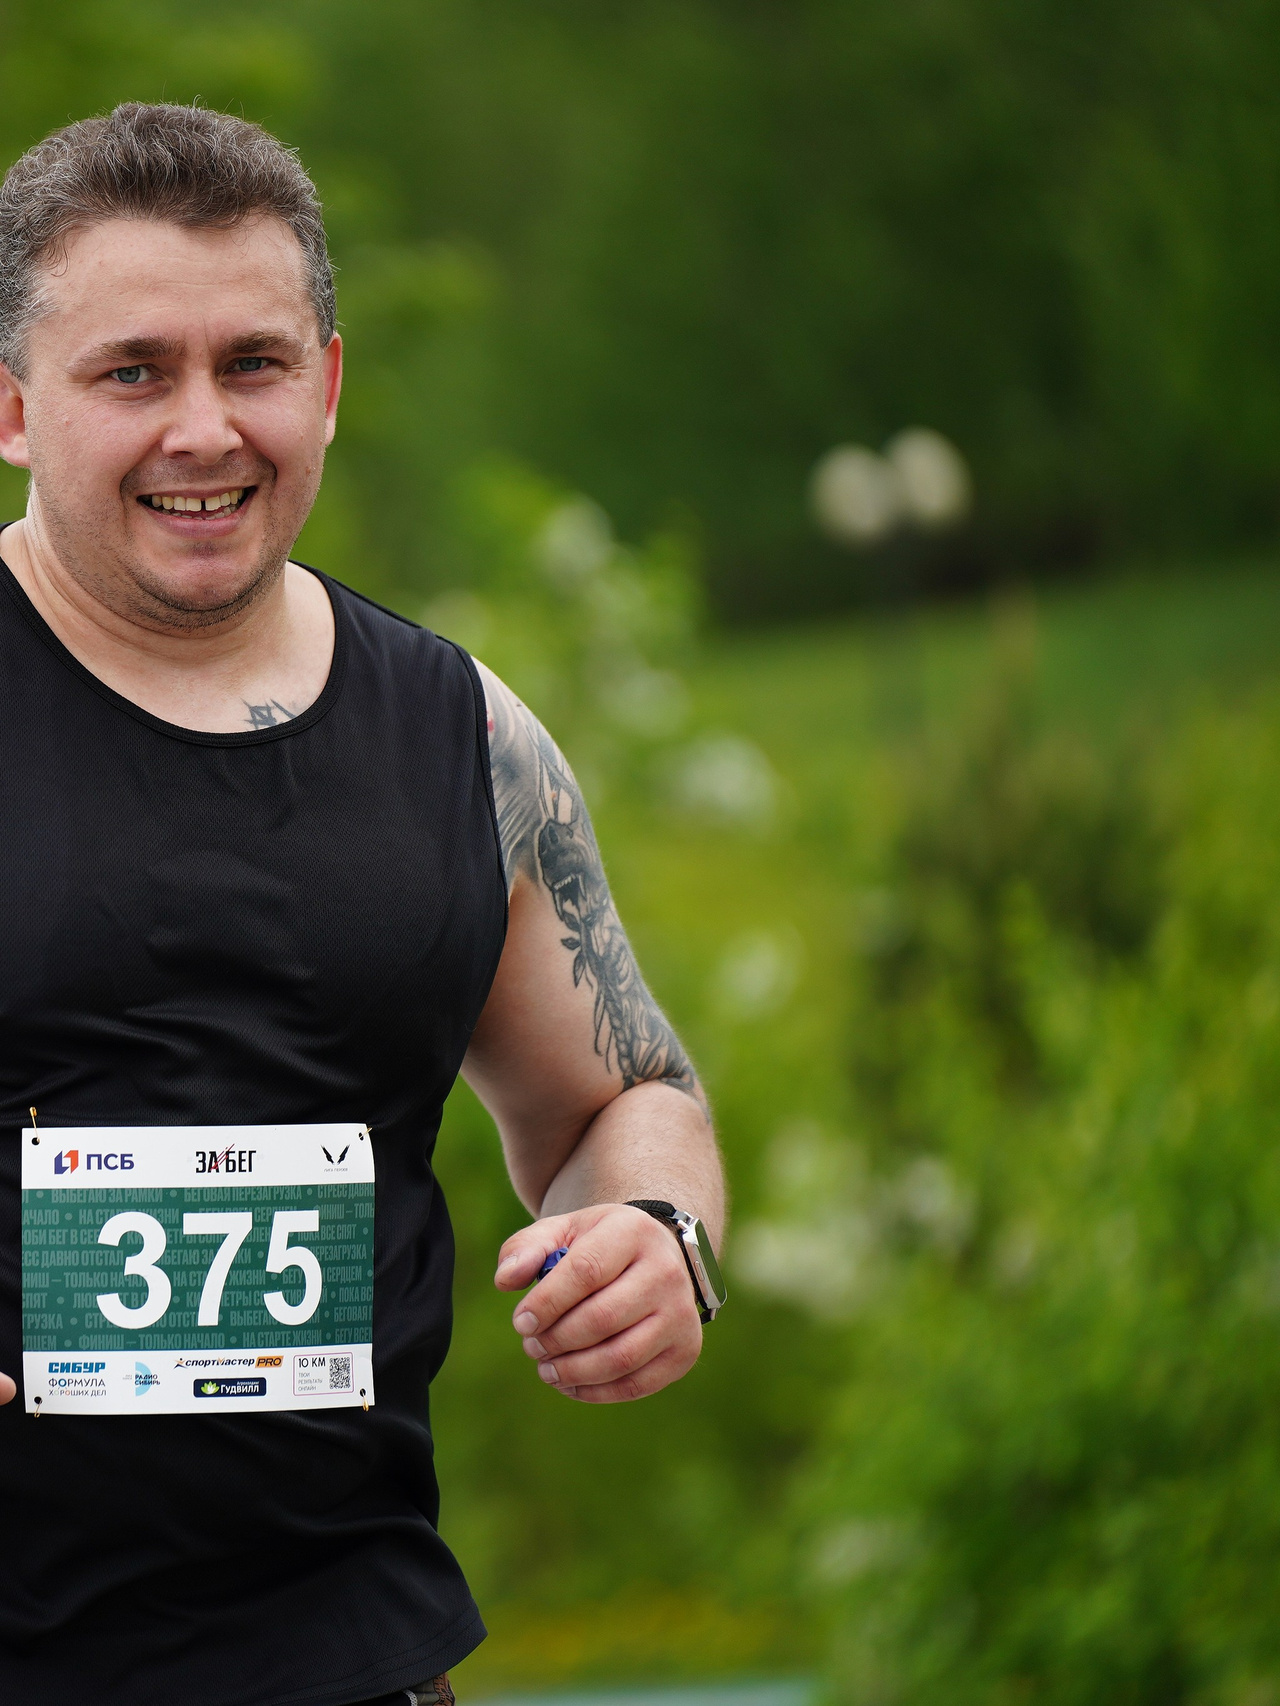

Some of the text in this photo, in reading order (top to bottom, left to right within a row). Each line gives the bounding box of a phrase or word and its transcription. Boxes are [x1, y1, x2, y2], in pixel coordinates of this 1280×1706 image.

[86, 1153, 135, 1170] ПСБ
[51, 1188, 107, 1203] ВЫБЕГАЮ
[108, 1188, 123, 1203] ЗА
[124, 1188, 163, 1203] РАМКИ
[183, 1187, 230, 1202] БЕГОВАЯ
[232, 1185, 302, 1201] ПЕРЕЗАГРУЗКА
[317, 1184, 347, 1199] СТРЕСС
[78, 1209, 94, 1225] НА
[48, 1229, 68, 1245] БЕГ
[70, 1229, 78, 1245] В
[321, 1225, 336, 1240] ВСЕ
[336, 1224, 357, 1239] СПЯТ
[41, 1250, 79, 1268] ДАВНО
[81, 1250, 124, 1266] ОТСТАЛ
[63, 1271, 108, 1288] ТОЛЬКО
[173, 1271, 187, 1287] НА
[228, 1269, 266, 1286] ЖИЗНИ
[282, 1268, 303, 1284] БЕГУ
[326, 1266, 362, 1283] СЕРДЦЕМ
[97, 1210, 322, 1329] 375
[339, 1286, 360, 1303] ПОКА
[333, 1306, 368, 1323] БЕГОВАЯ
[78, 1334, 125, 1350] ФИНИШ
[138, 1333, 181, 1350] ТОЛЬКО
[183, 1332, 225, 1349] НАЧАЛО
[242, 1331, 256, 1347] НА
[257, 1330, 291, 1347] СТАРТЕ
[292, 1329, 322, 1346] ЖИЗНИ
[335, 1328, 353, 1343] БЕГУ
[48, 1362, 106, 1373] СИБУР
[257, 1357, 282, 1366] PRO
[298, 1357, 309, 1368] 10
[48, 1378, 106, 1387] ФОРМУЛА
[220, 1384, 260, 1394] Гудвилл
[48, 1389, 106, 1397] ХОРОШИХ ДЕЛ
